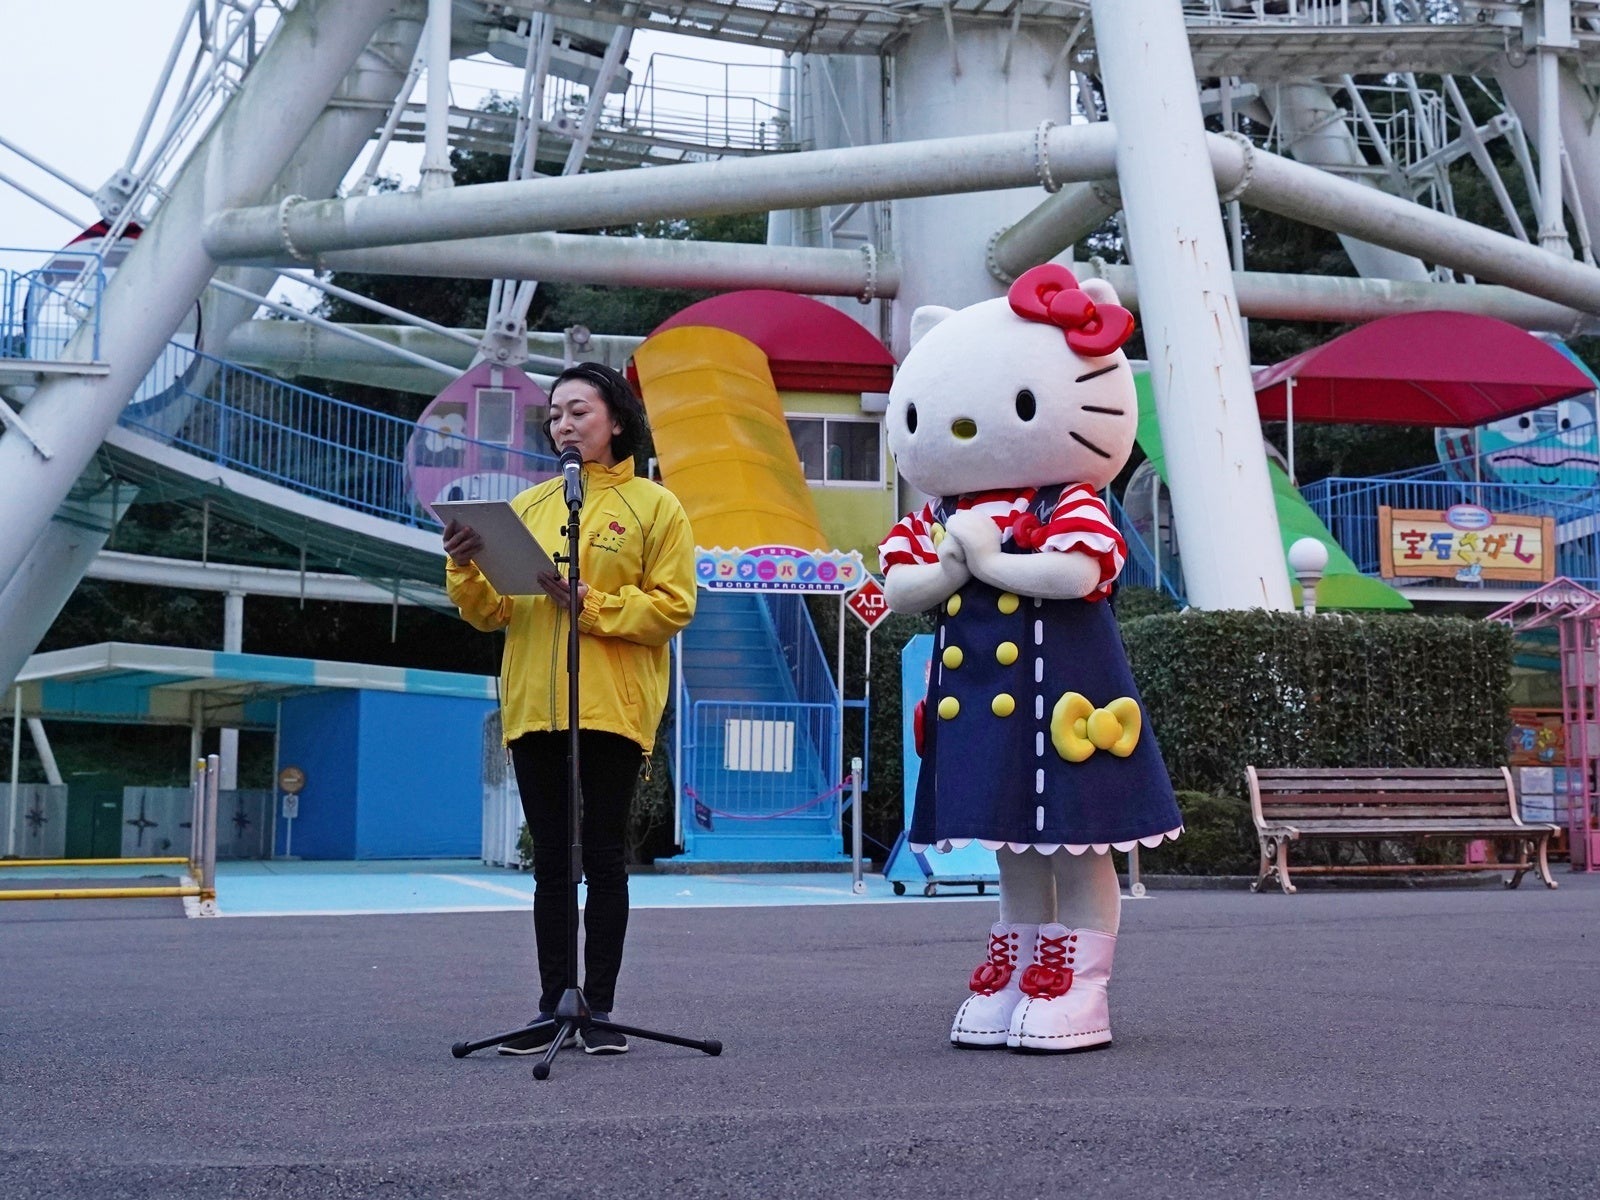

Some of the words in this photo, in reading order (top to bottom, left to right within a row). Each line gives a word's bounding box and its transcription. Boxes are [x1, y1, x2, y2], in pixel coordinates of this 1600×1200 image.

[1400, 529, 1535, 564] 宝石さがし
[856, 593, 885, 608] 入口
